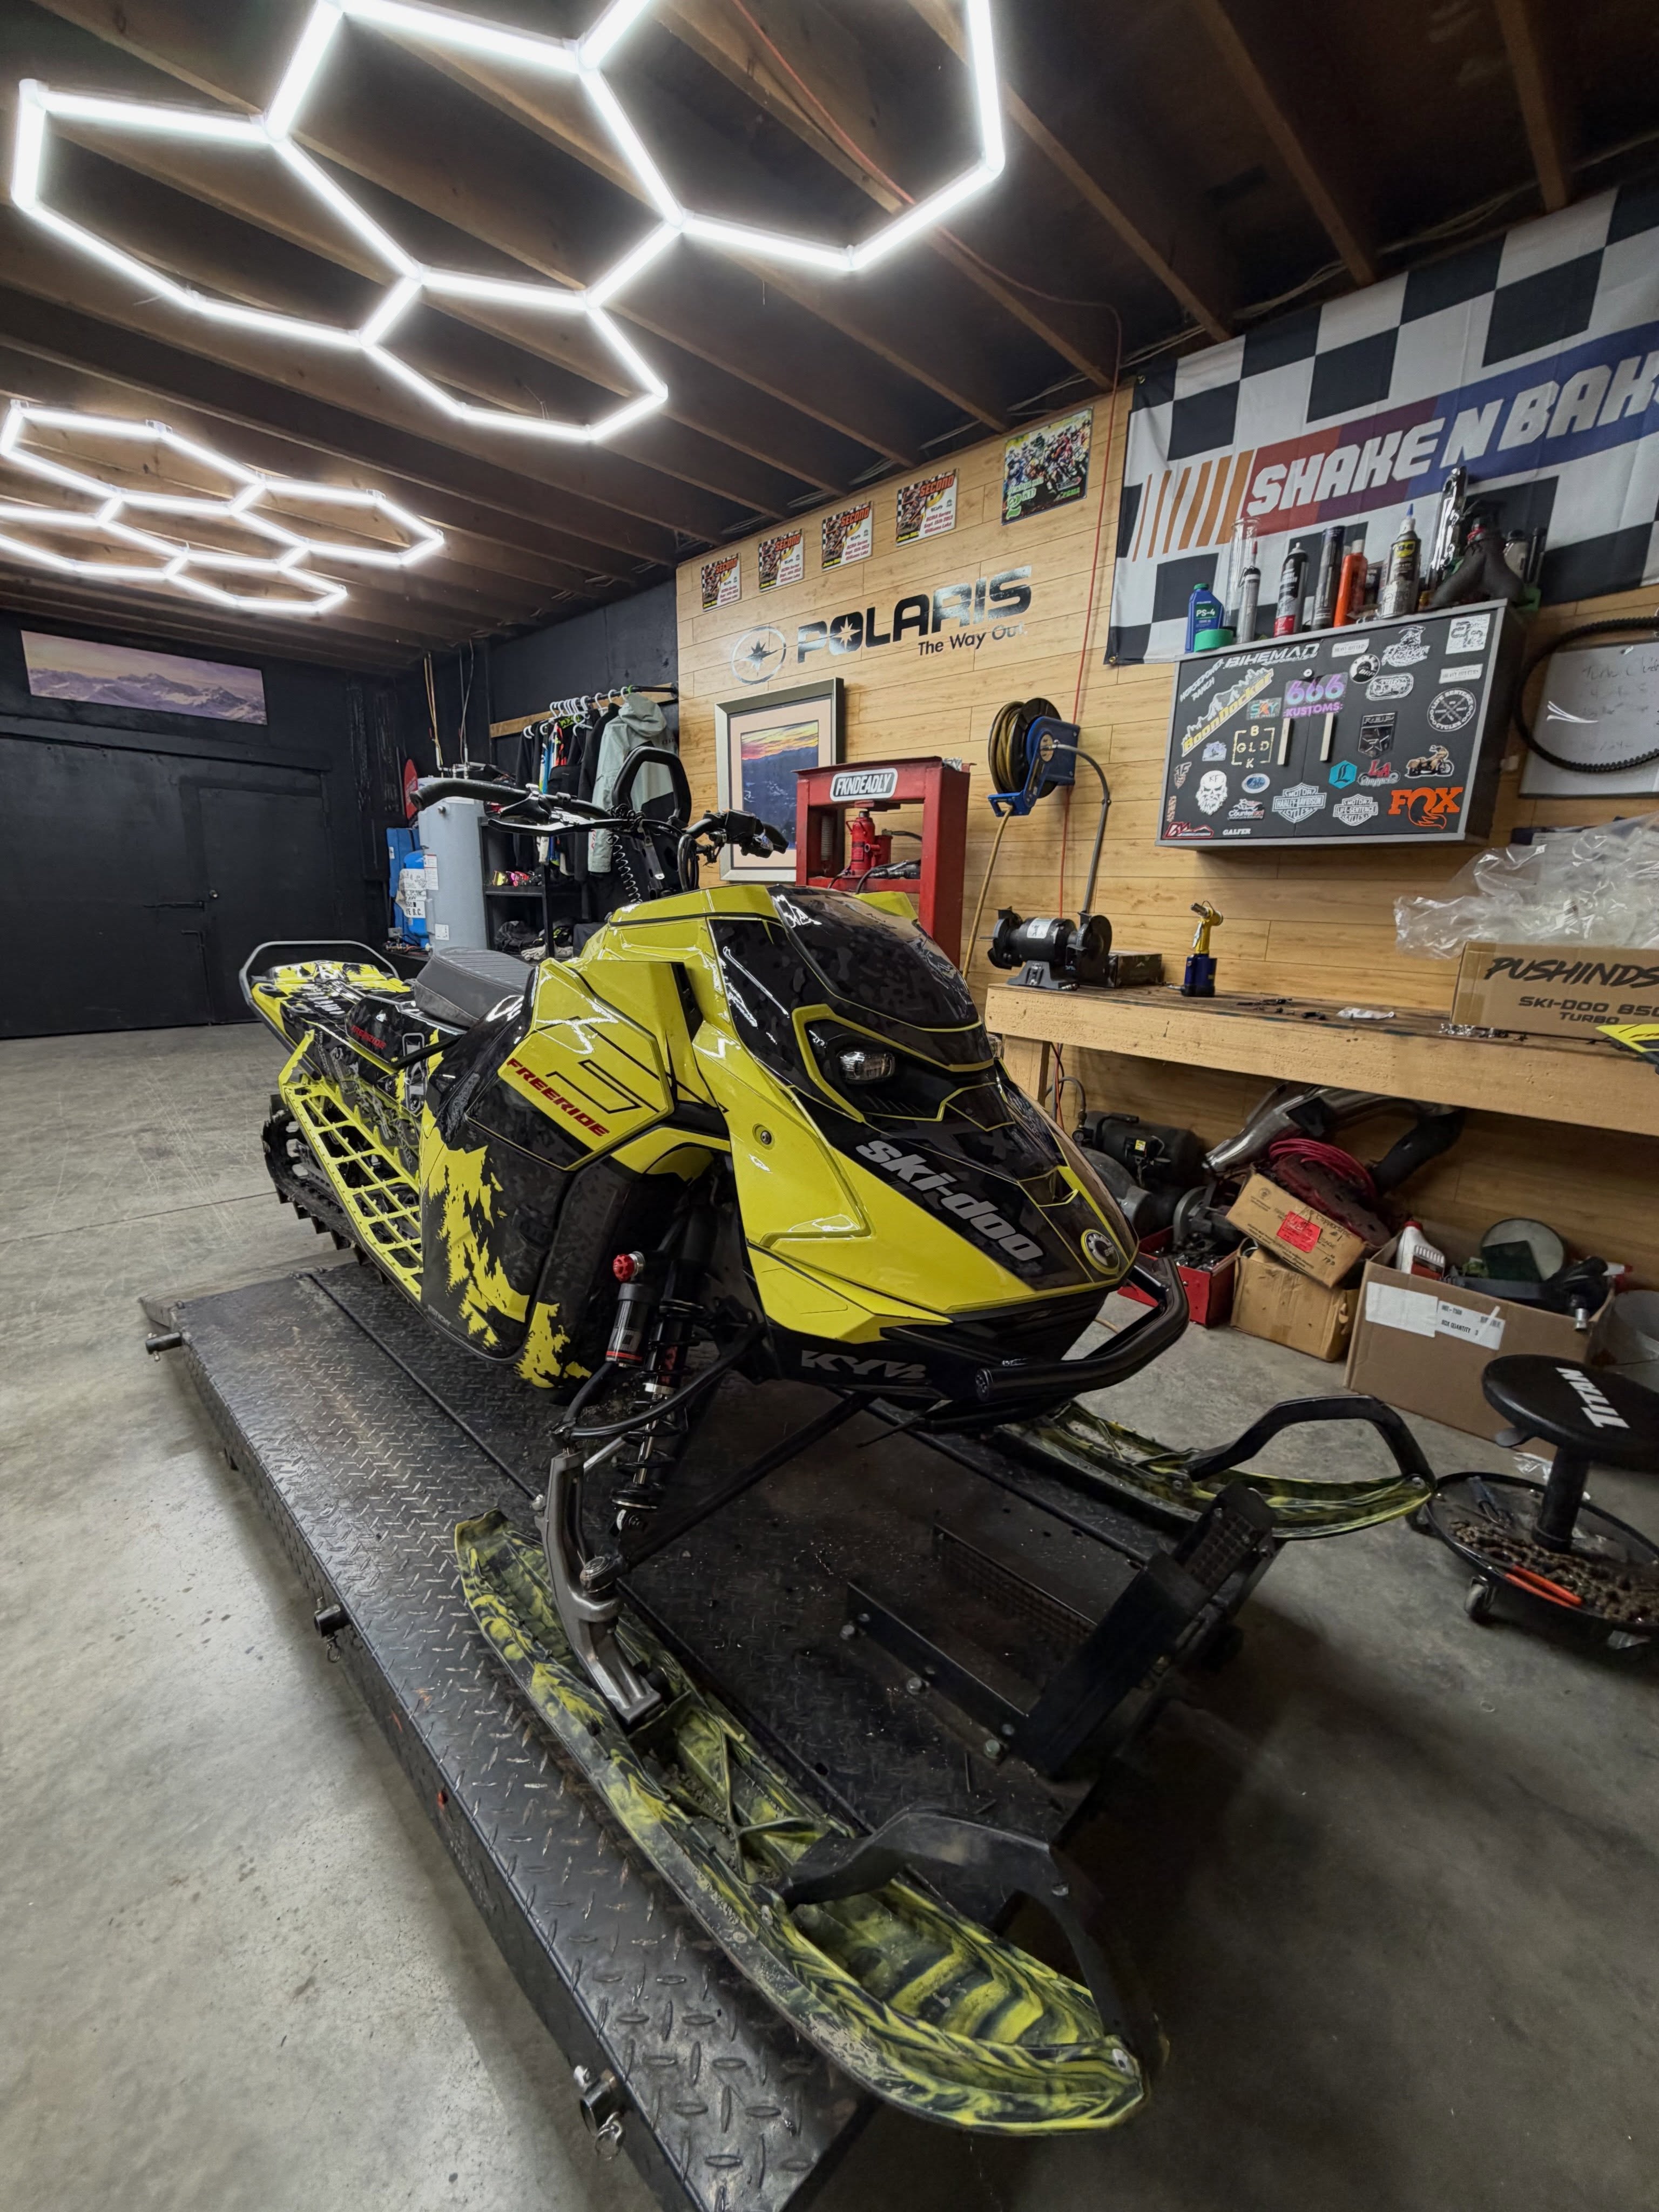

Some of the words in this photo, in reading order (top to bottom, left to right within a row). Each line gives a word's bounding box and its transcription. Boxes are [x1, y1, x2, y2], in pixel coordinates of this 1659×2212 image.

[1246, 417, 1446, 517] SHAKE
[1440, 399, 1505, 468] N
[1498, 351, 1659, 451] BAK
[920, 475, 955, 497] SECOND
[841, 507, 870, 528] SECOND
[775, 534, 801, 552] SECOND
[798, 564, 1032, 664] POLARIS
[1196, 608, 1216, 617] PS-4
[919, 641, 944, 656] The
[950, 629, 987, 650] Way
[1287, 673, 1345, 705] 666
[835, 774, 892, 797] FKNDEADLY
[1388, 787, 1464, 820] FOX
[1518, 996, 1609, 1013] SKI-DOO
[1560, 1011, 1620, 1024] TURBO
[507, 1057, 610, 1137] FREERIDE
[1451, 1322, 1471, 1333] QUANTITY
[1555, 1367, 1630, 1428] TITAN
